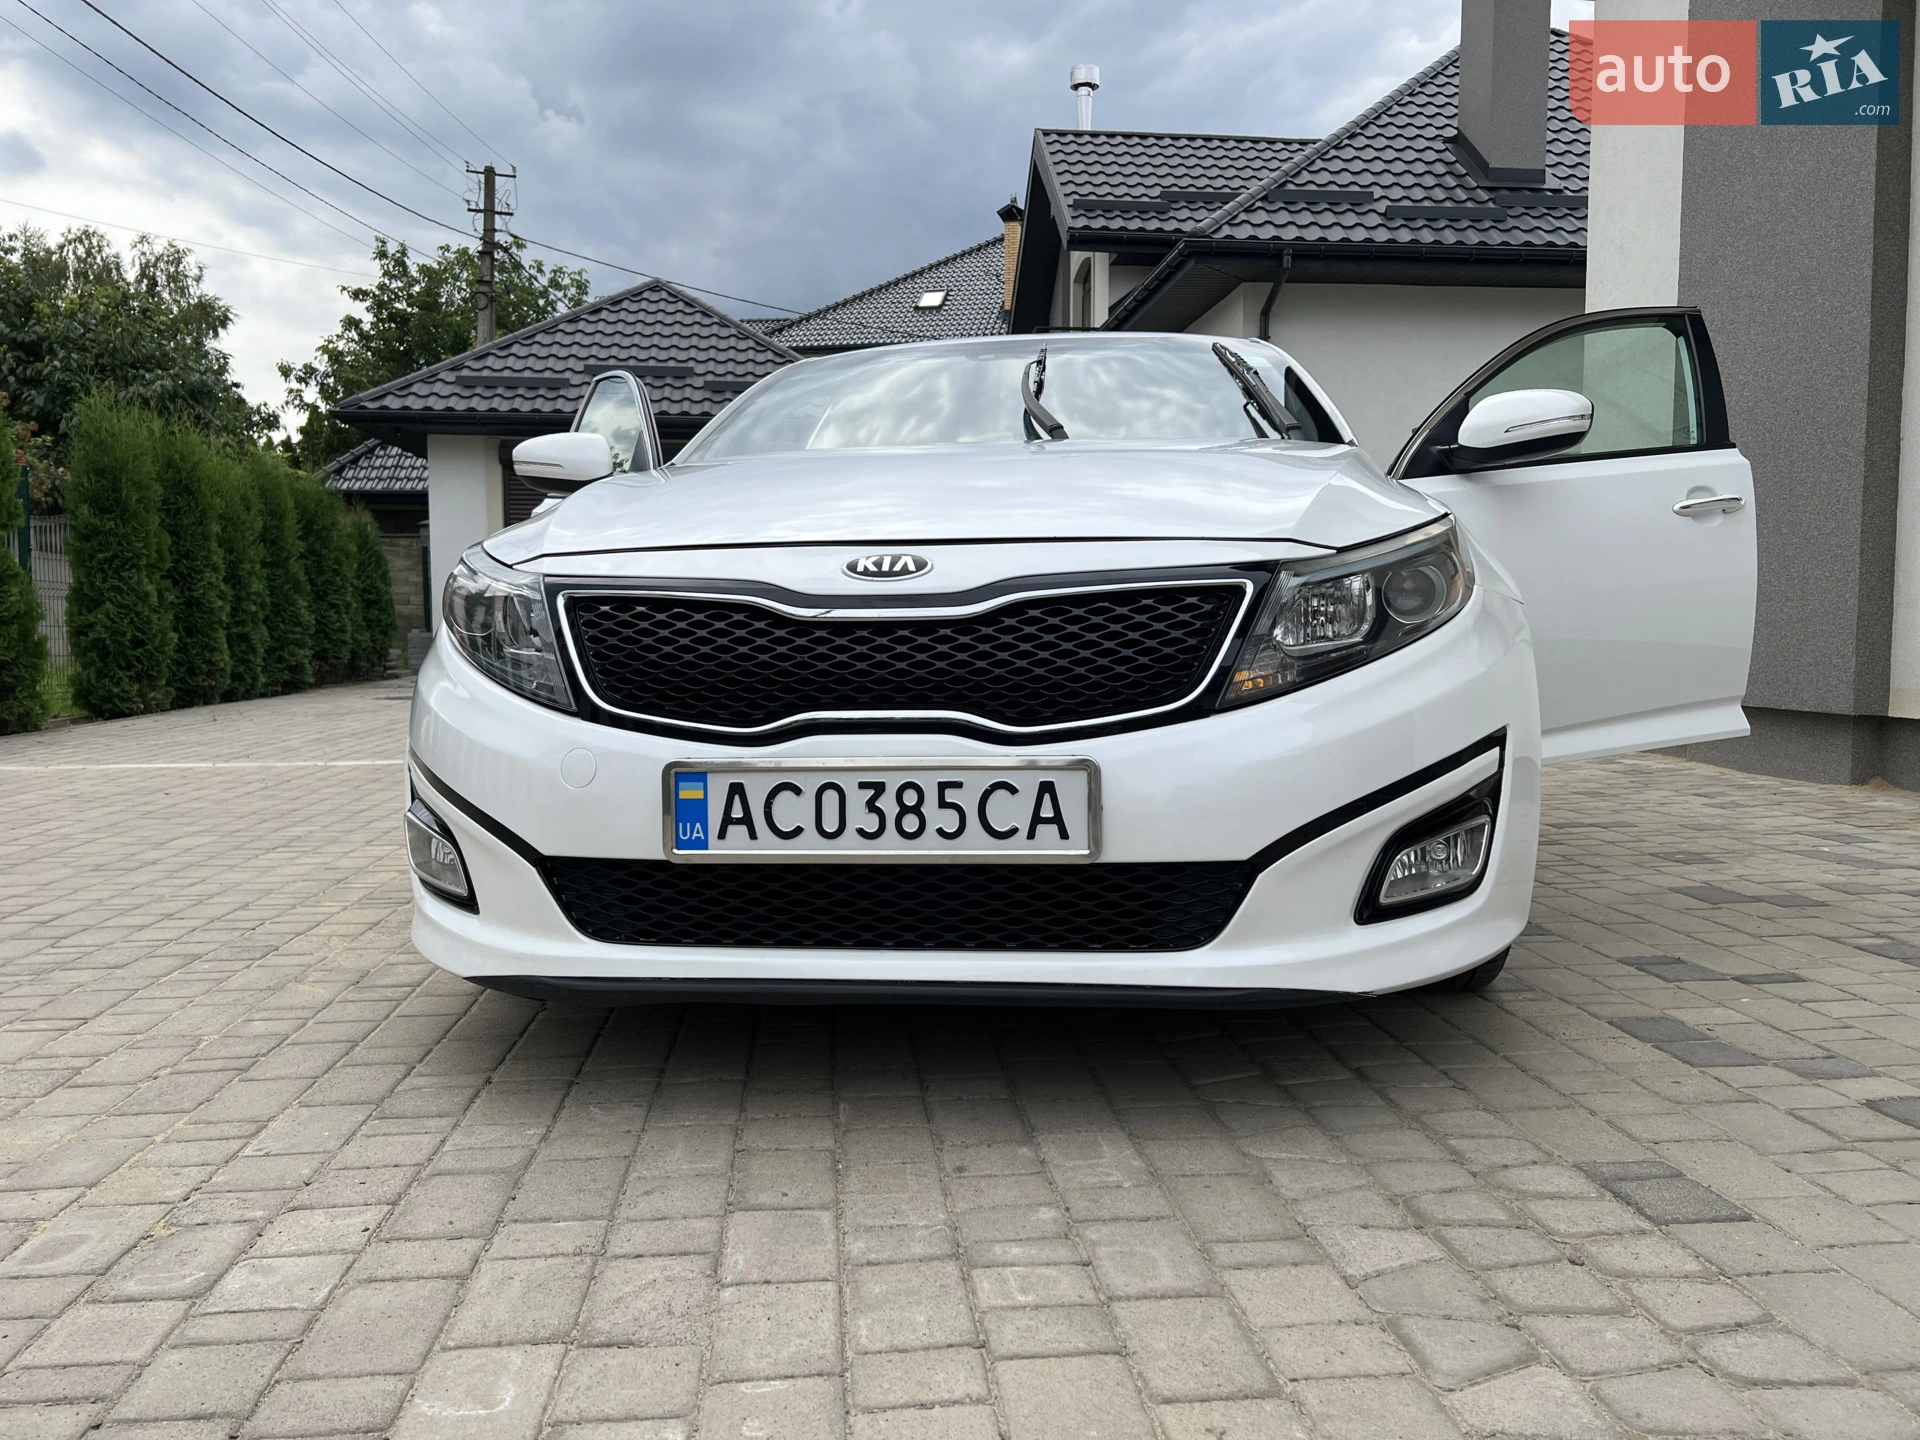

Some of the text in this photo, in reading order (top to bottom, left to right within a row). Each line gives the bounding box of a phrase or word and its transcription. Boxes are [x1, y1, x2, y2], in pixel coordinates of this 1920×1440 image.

[856, 555, 917, 572] KIA
[716, 780, 1070, 840] AC0385CA
[678, 822, 705, 840] UA
